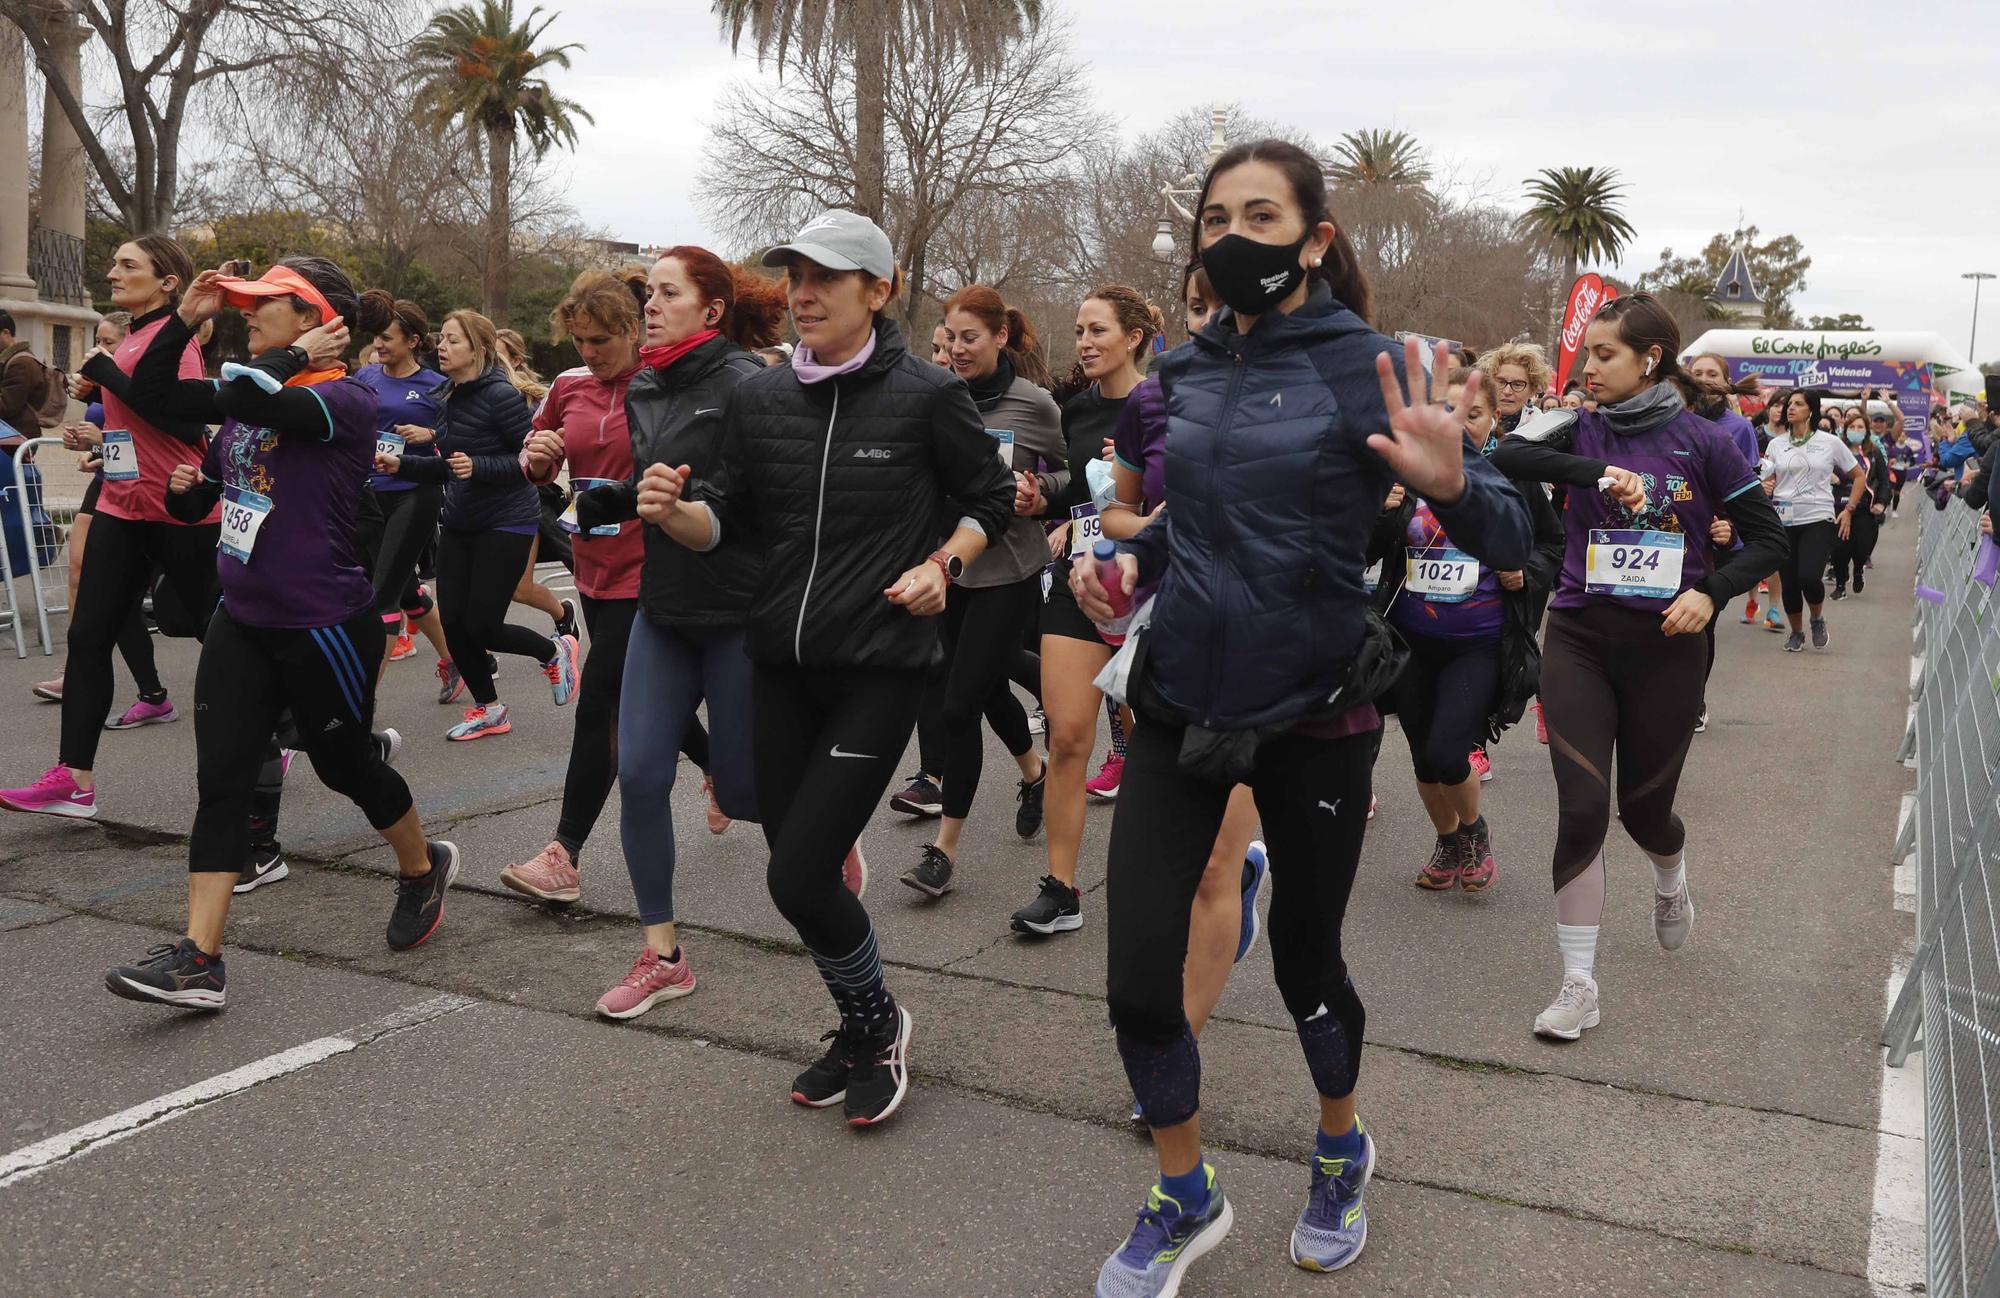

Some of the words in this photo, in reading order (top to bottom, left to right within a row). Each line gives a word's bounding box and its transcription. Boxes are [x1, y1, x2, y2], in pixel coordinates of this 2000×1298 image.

[1260, 270, 1289, 286] Reebok
[1562, 280, 1600, 352] Coca-Cola
[1752, 337, 1770, 354] El
[1771, 337, 1815, 354] Corte
[1817, 335, 1882, 360] Inglés
[1740, 362, 1786, 374] Carrera
[1788, 360, 1819, 375] 10K
[1829, 366, 1872, 378] Valencia
[1800, 373, 1826, 386] FEM
[865, 448, 892, 459] ABC
[1665, 480, 1688, 492] 10K
[1675, 492, 1691, 500] FEM
[223, 503, 253, 533] 1458
[1611, 547, 1661, 571] 924
[1418, 562, 1465, 581] 1021
[1620, 574, 1647, 583] ZAIDA
[1427, 584, 1452, 592] Amparo
